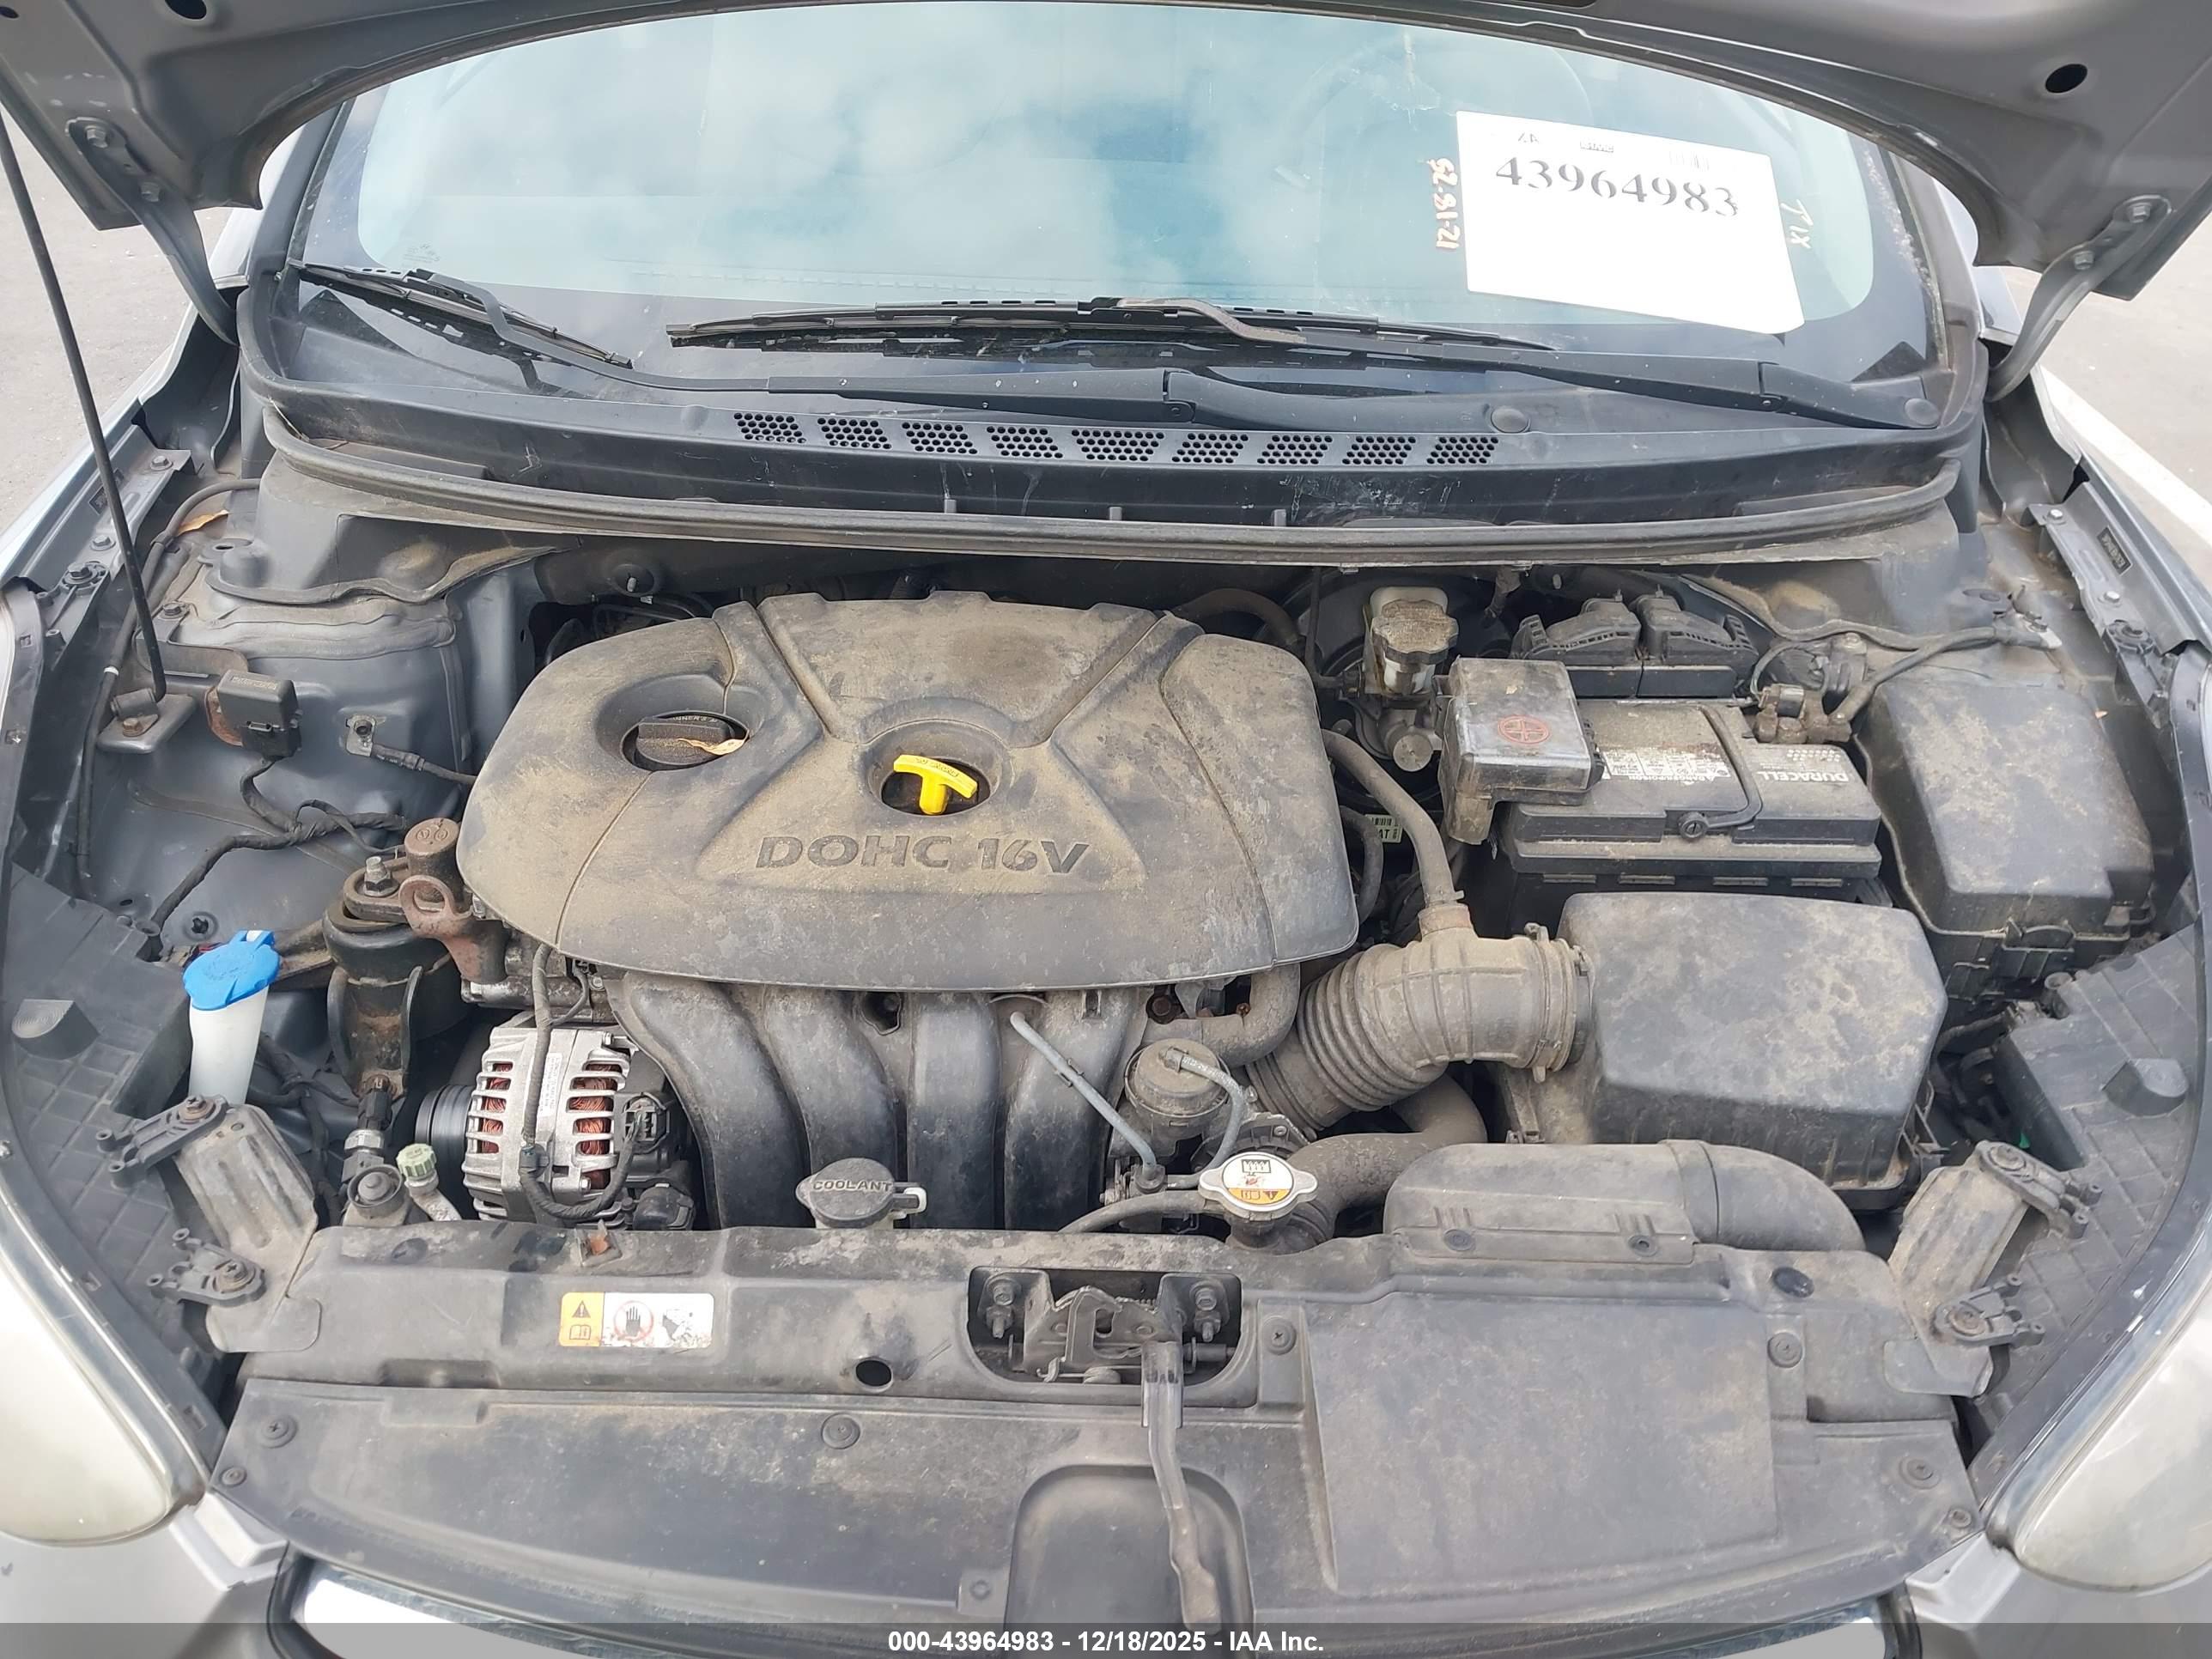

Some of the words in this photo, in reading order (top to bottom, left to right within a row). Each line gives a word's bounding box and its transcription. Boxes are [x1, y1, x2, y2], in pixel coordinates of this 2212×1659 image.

[1495, 156, 1739, 217] 43964983
[1756, 770, 1849, 782] DURACELL
[756, 835, 951, 869] DOHC
[977, 837, 1091, 874] 16V
[812, 1179, 893, 1192] COOLANT
